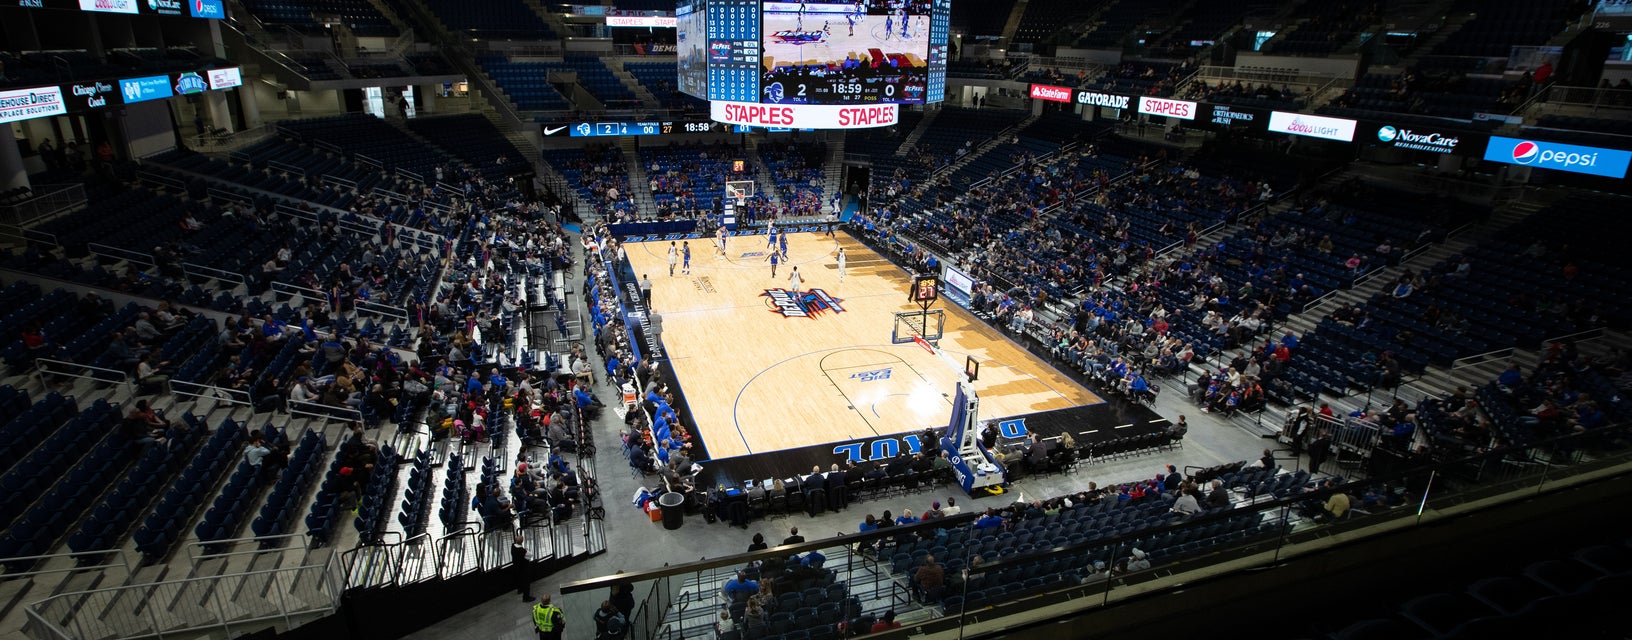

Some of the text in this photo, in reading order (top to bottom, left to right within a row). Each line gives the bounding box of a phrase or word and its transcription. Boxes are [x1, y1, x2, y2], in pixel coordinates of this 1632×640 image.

[73, 84, 96, 96] Chicago
[798, 84, 806, 96] 2
[832, 84, 862, 94] 18:59
[885, 84, 894, 96] 0
[0, 92, 55, 108] EHOUSE DIRECT
[88, 96, 106, 108] Coach
[1078, 92, 1130, 109] GATORADE
[26, 104, 59, 114] SOLUTIONS
[1145, 100, 1188, 116] STAPLES
[725, 104, 794, 125] STAPLES
[839, 106, 894, 126] STAPLES
[1213, 110, 1254, 120] ORTHOPAEDICS
[605, 125, 611, 133] 2
[684, 123, 709, 132] 18:58
[1288, 120, 1338, 136] Coors LIGHT
[1396, 129, 1458, 147] NovaCare
[1394, 142, 1453, 153] REHABILITATION
[1540, 148, 1598, 168] pepsi
[624, 233, 702, 242] BLUE
[920, 287, 934, 298] 27
[848, 367, 892, 379] EAST
[861, 374, 891, 382] BIG
